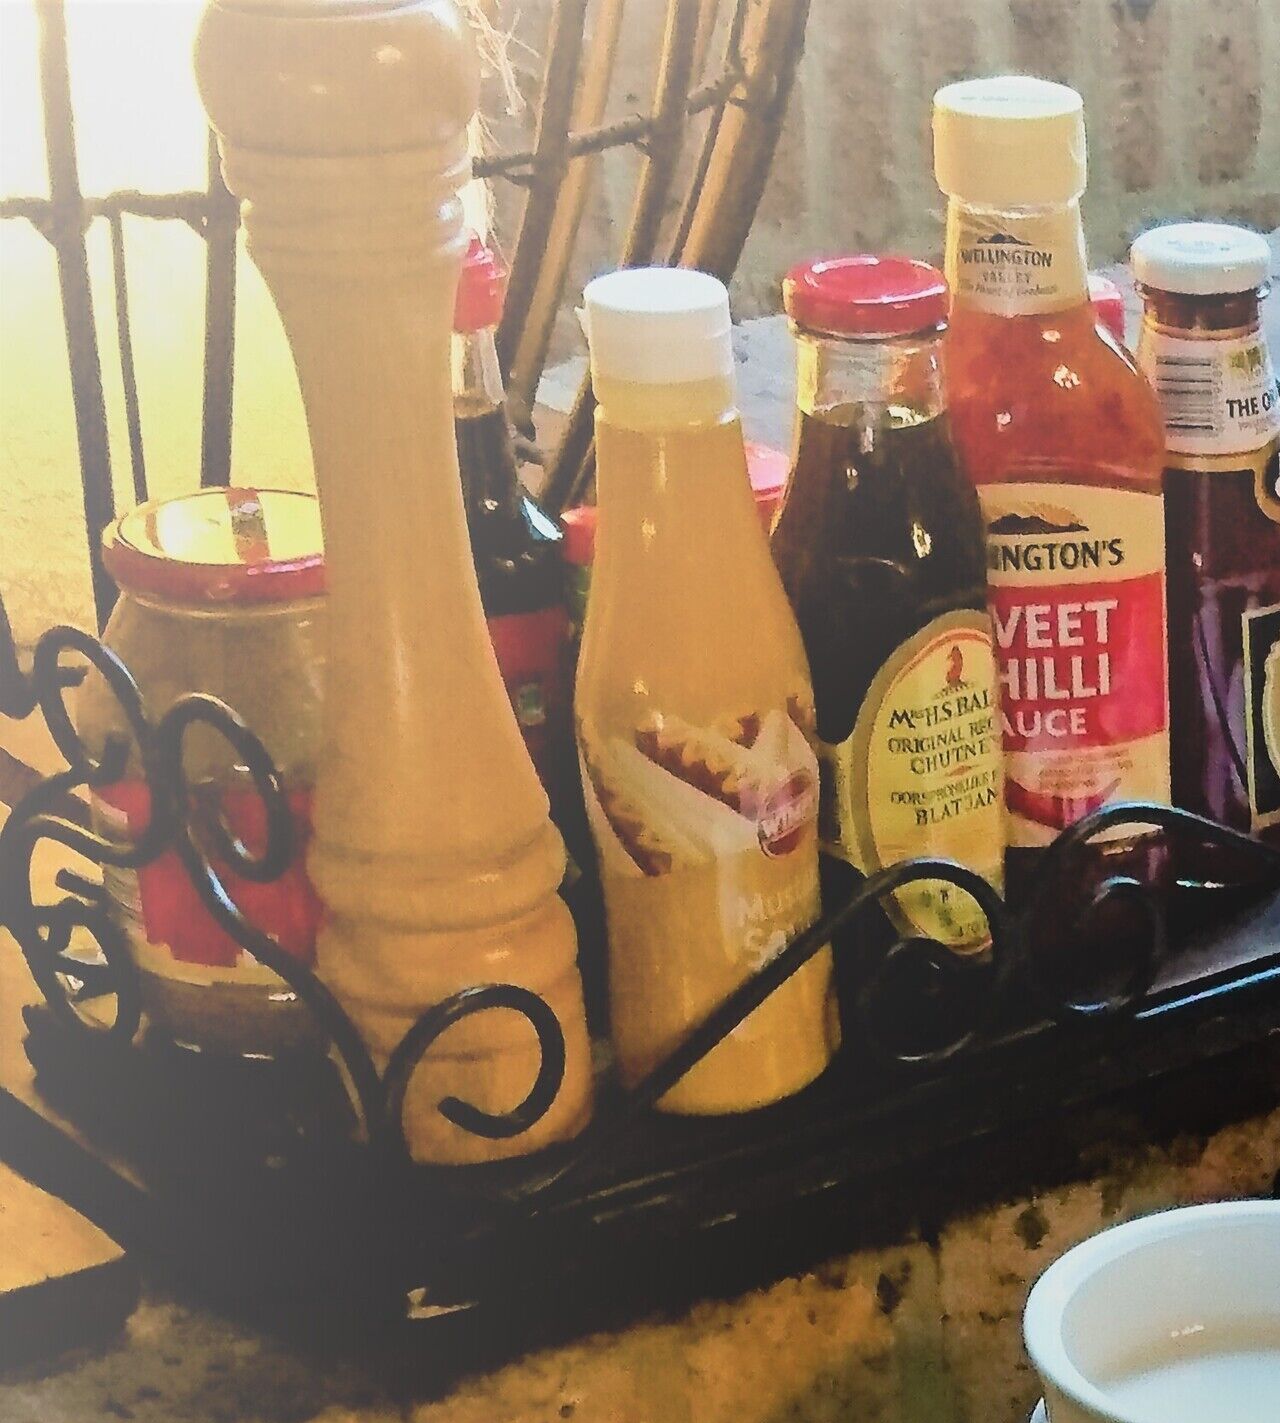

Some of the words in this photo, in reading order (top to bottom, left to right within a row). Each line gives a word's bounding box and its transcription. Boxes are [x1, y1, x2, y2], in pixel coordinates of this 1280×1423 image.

[960, 248, 1053, 268] WELLINGTON
[1226, 396, 1259, 418] THE
[991, 538, 1126, 572] INGTON'S
[1000, 653, 1111, 701] HILLI
[888, 727, 966, 754] ORIGINAL
[910, 738, 992, 775] CHUTNE
[915, 787, 997, 826] BLATJAN
